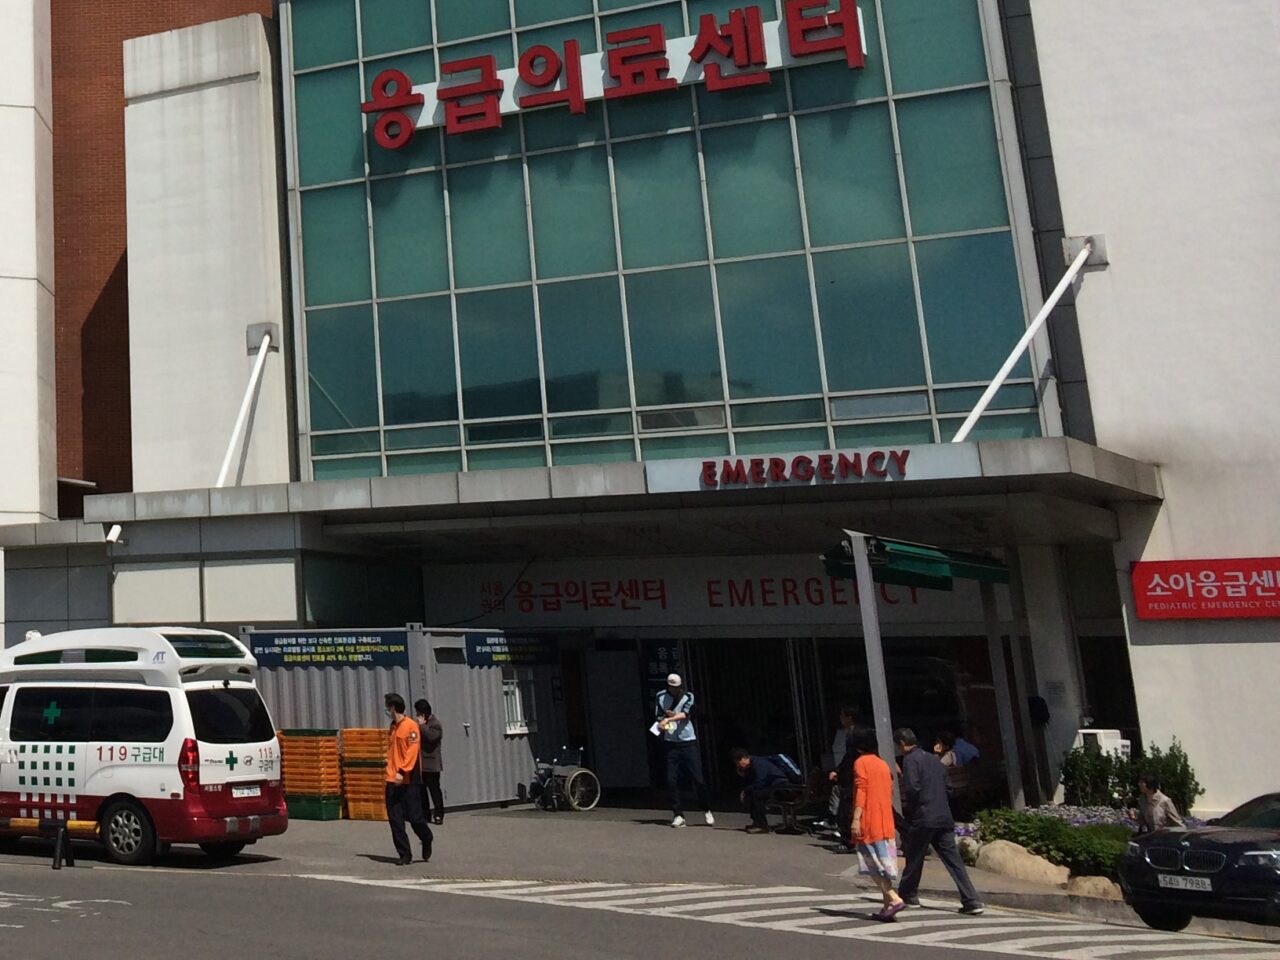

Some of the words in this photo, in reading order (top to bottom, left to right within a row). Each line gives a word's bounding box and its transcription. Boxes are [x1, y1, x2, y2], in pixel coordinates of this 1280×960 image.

[702, 449, 910, 487] EMERGENCY
[513, 578, 667, 613] 응급의료센터
[707, 575, 921, 608] EMERGECY
[1148, 601, 1198, 610] PEDIATRIC
[1201, 600, 1261, 610] EMERGENCY
[97, 745, 128, 762] 119
[131, 746, 165, 763] 구급대
[259, 747, 273, 759] 119
